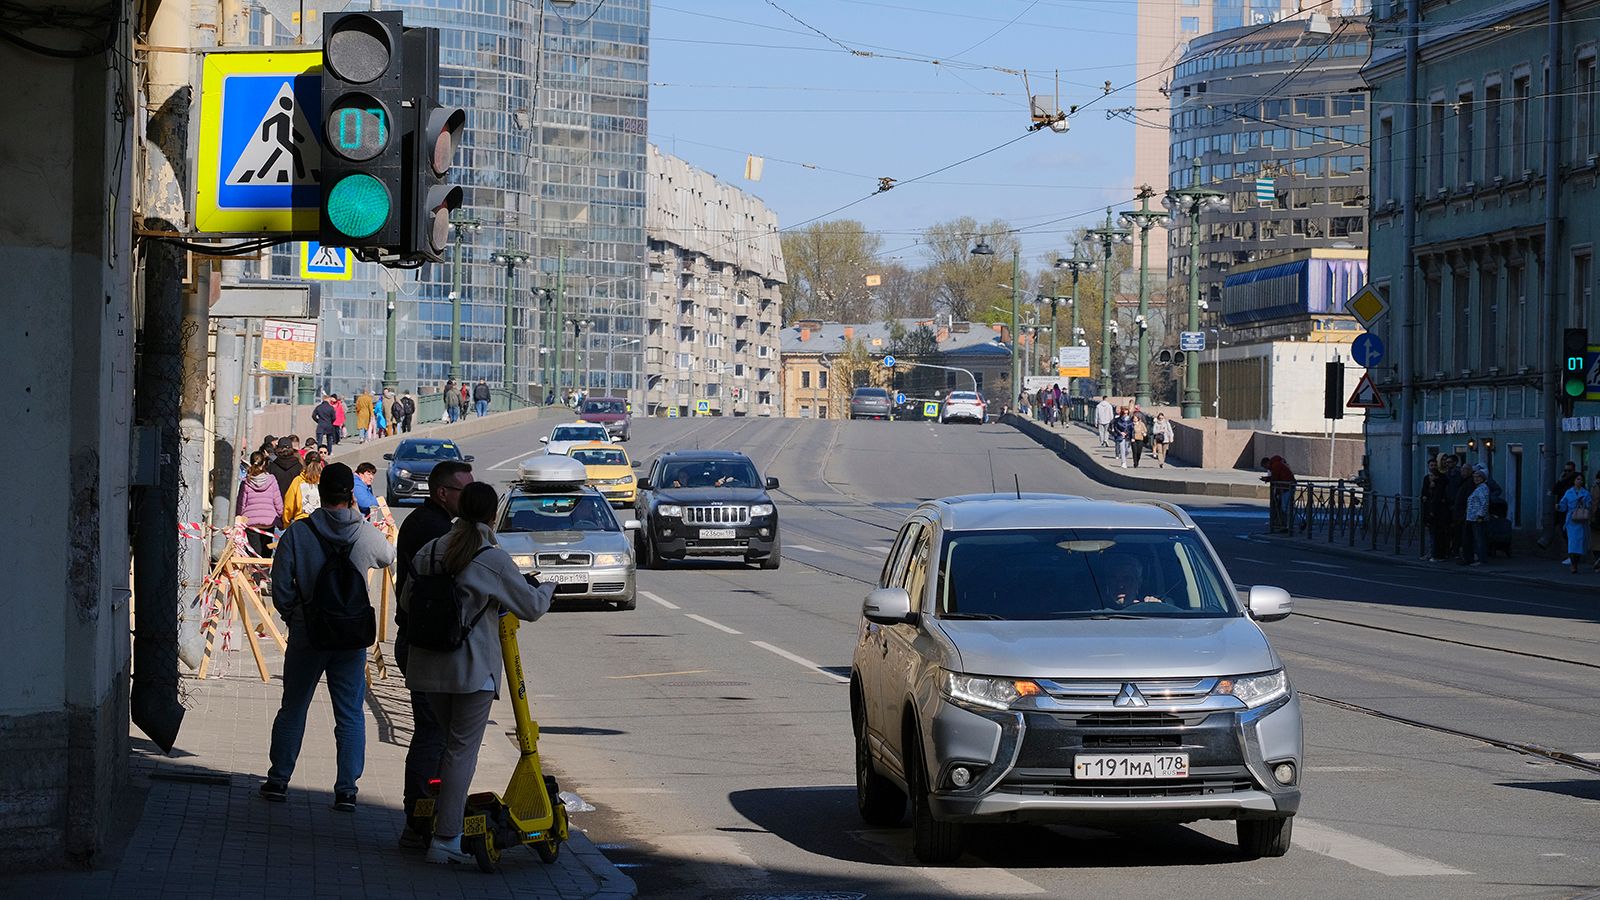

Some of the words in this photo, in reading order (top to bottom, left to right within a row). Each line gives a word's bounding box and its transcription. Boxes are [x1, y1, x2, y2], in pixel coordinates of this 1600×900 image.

[340, 107, 385, 150] 07
[1568, 357, 1584, 371] 07
[1082, 758, 1153, 776] Т191МА
[1157, 756, 1183, 770] 178
